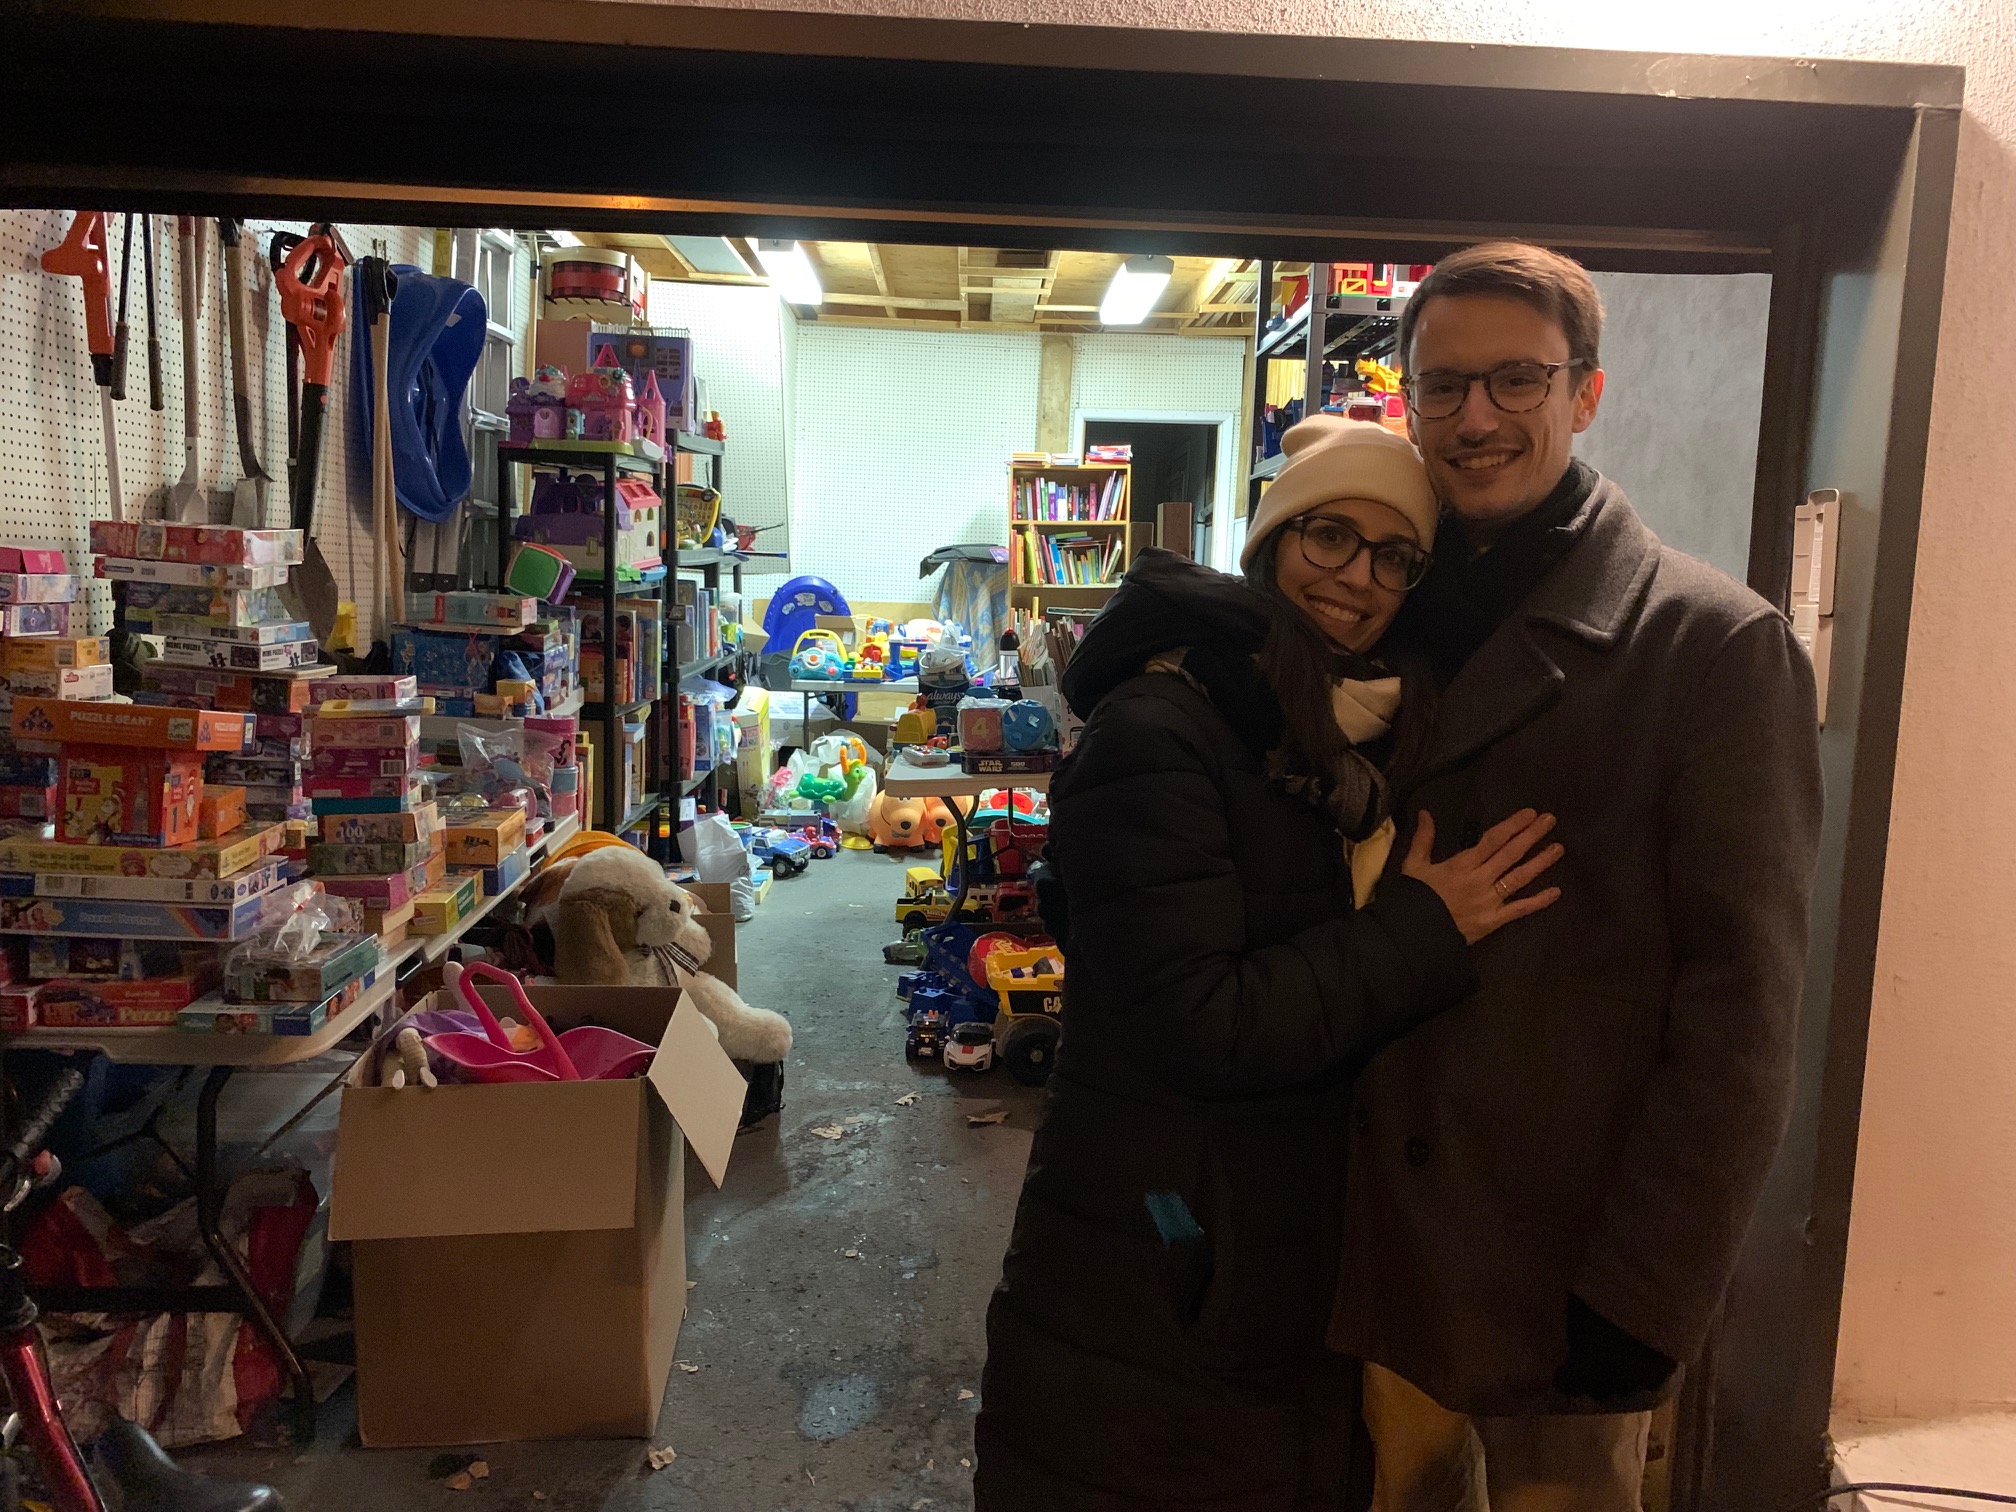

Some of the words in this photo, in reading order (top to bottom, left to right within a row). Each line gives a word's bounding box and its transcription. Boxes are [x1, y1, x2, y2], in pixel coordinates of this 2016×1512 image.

[926, 689, 962, 704] always
[70, 711, 112, 724] PUZZLE
[971, 717, 989, 738] 4
[340, 826, 363, 838] 100
[1043, 996, 1062, 1014] CA
